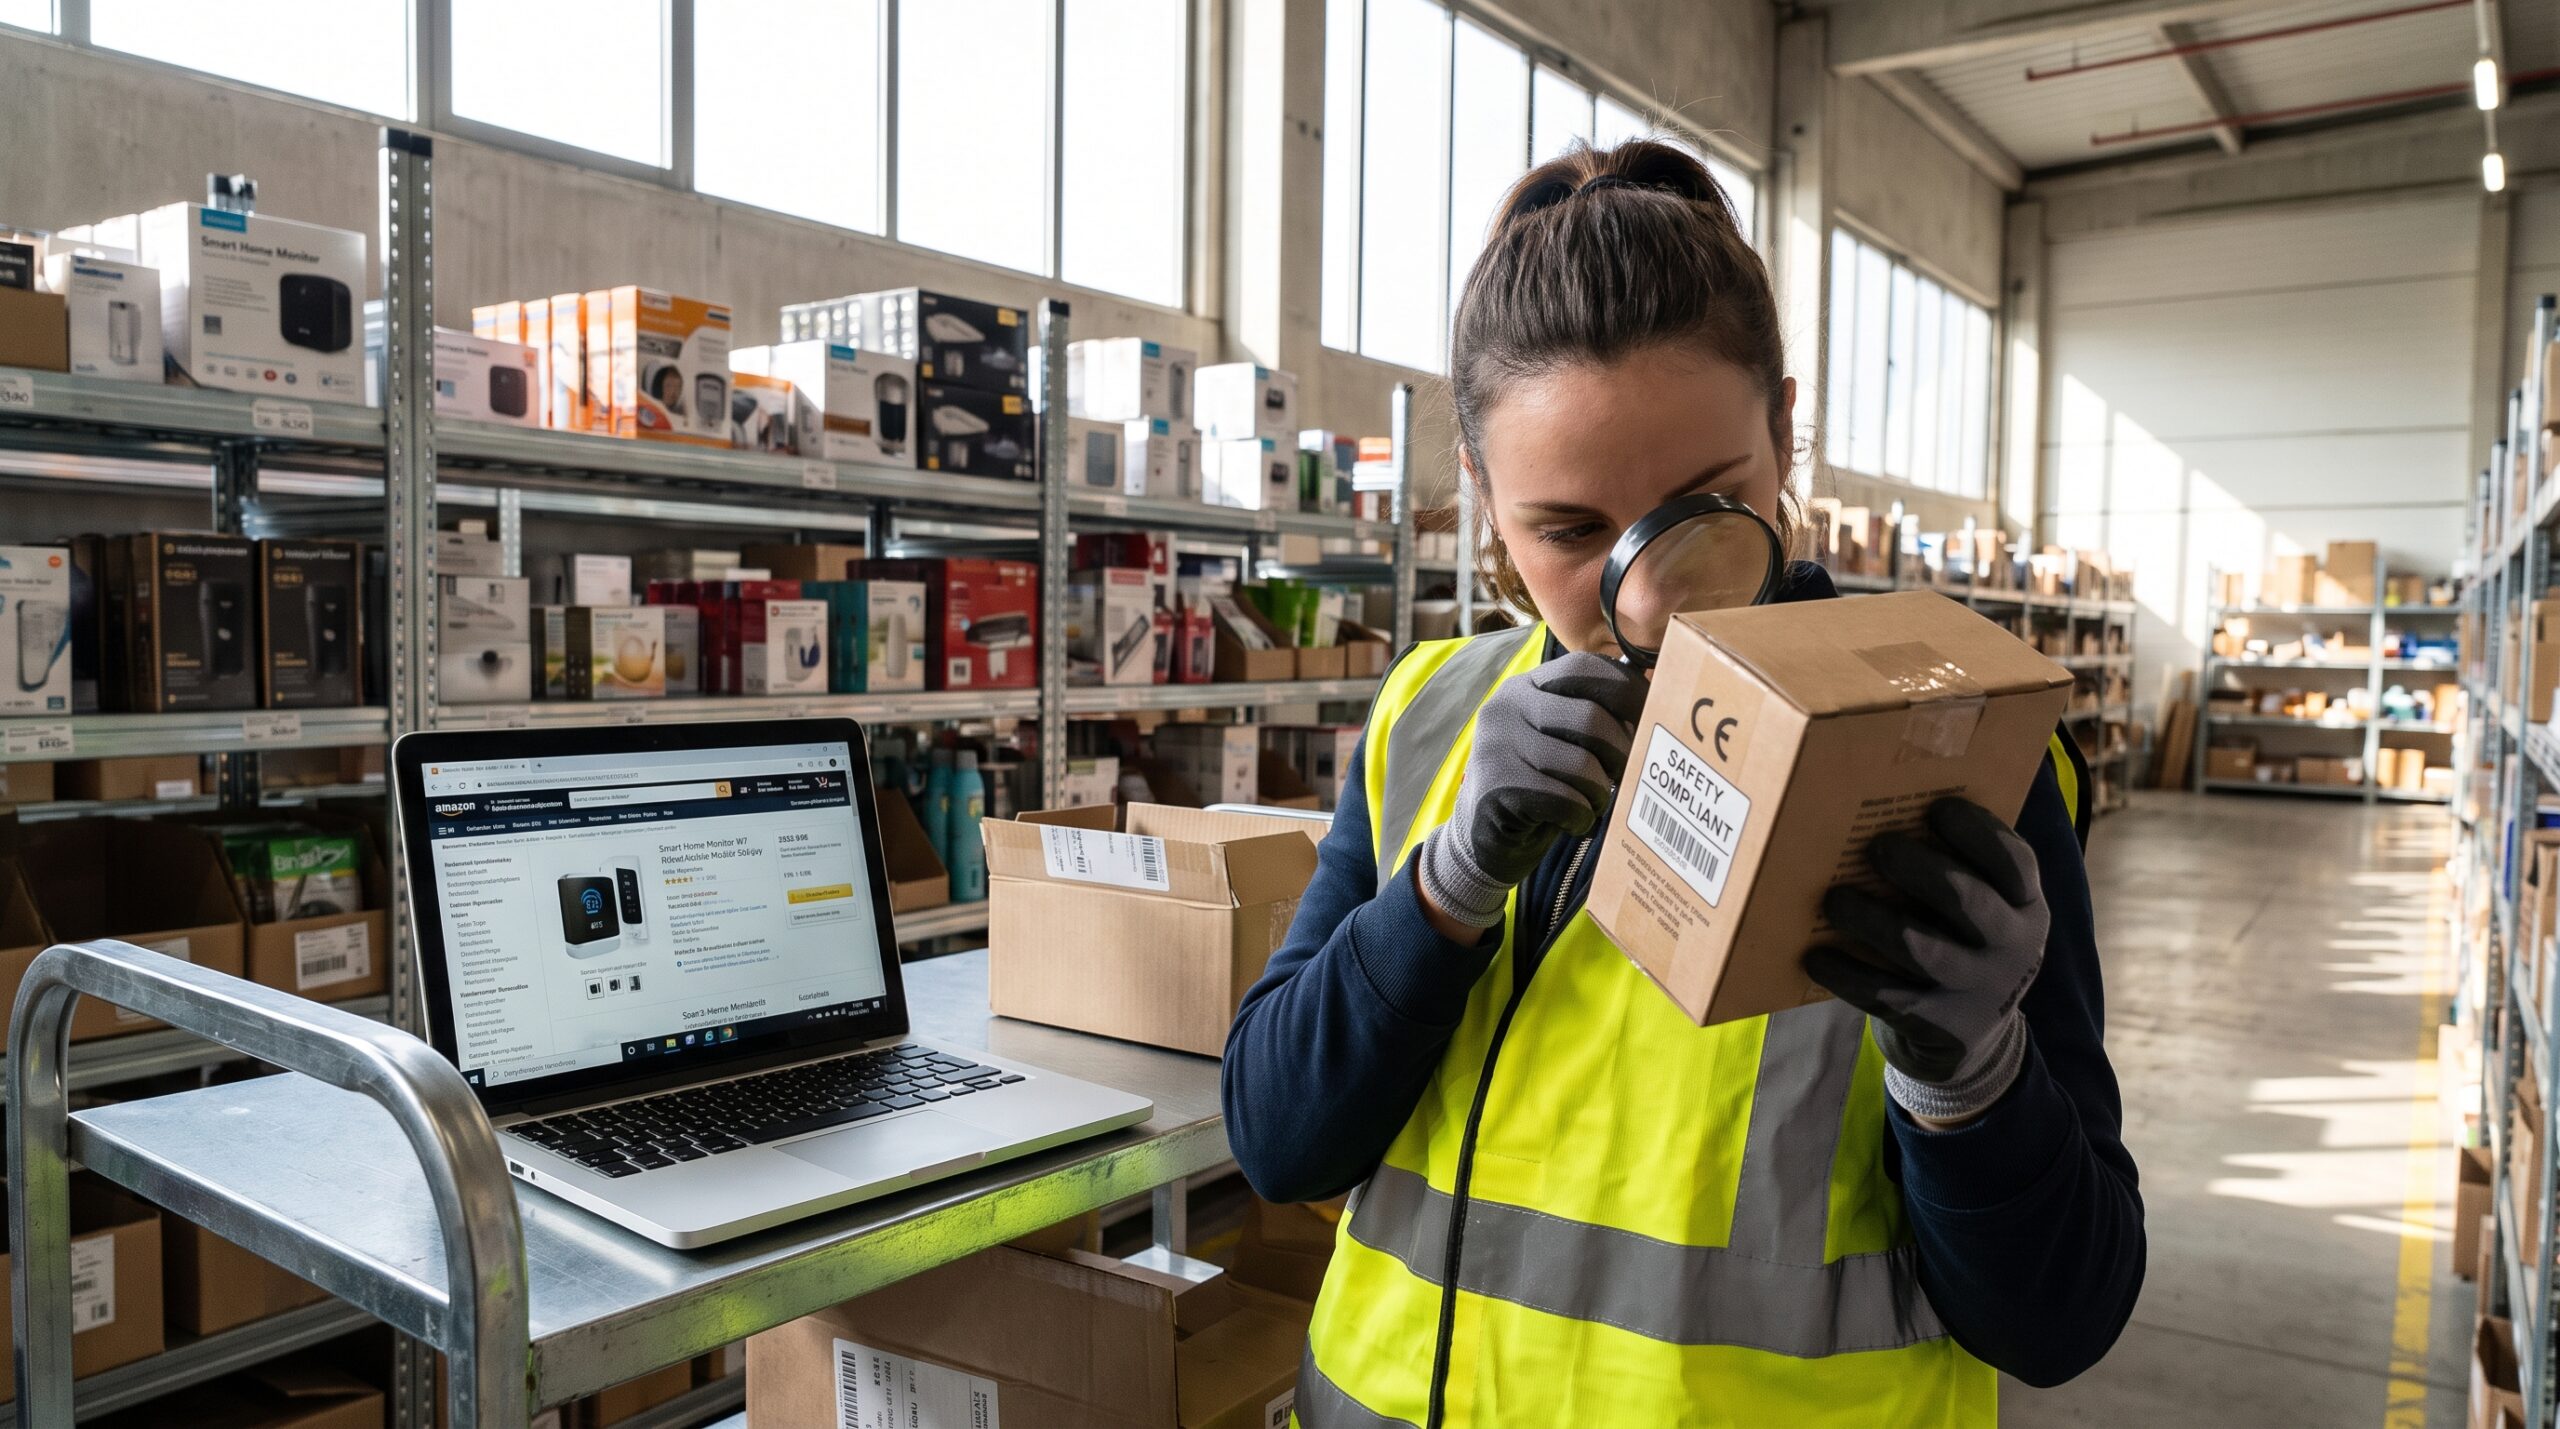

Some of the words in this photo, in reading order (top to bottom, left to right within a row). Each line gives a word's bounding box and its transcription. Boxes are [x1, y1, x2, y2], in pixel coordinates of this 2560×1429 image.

[201, 235, 237, 250] Smart
[240, 243, 274, 257] Home
[277, 248, 320, 264] Monitor
[1691, 697, 1738, 763] CE
[1667, 749, 1724, 804] SAFETY
[435, 802, 476, 814] amazon
[1649, 762, 1733, 842] COMPLIANT
[659, 844, 682, 853] Smart
[683, 842, 705, 851] Home
[706, 839, 734, 849] Monitor
[735, 837, 748, 846] W7
